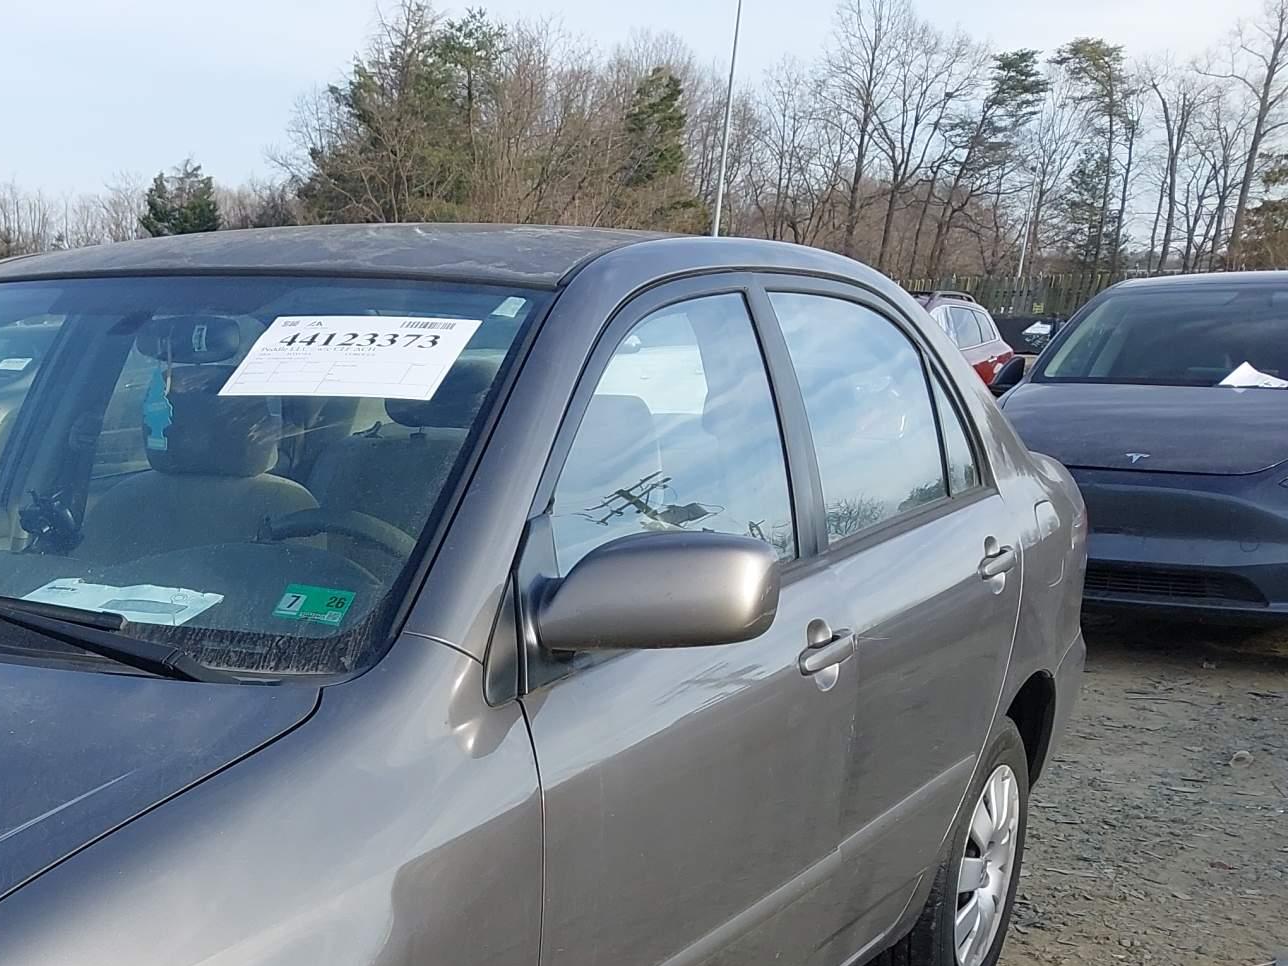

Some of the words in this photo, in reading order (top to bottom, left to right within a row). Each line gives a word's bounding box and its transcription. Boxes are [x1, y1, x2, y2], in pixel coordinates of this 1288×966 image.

[279, 332, 441, 349] 44123373
[286, 595, 302, 609] 7
[325, 596, 346, 609] 26
